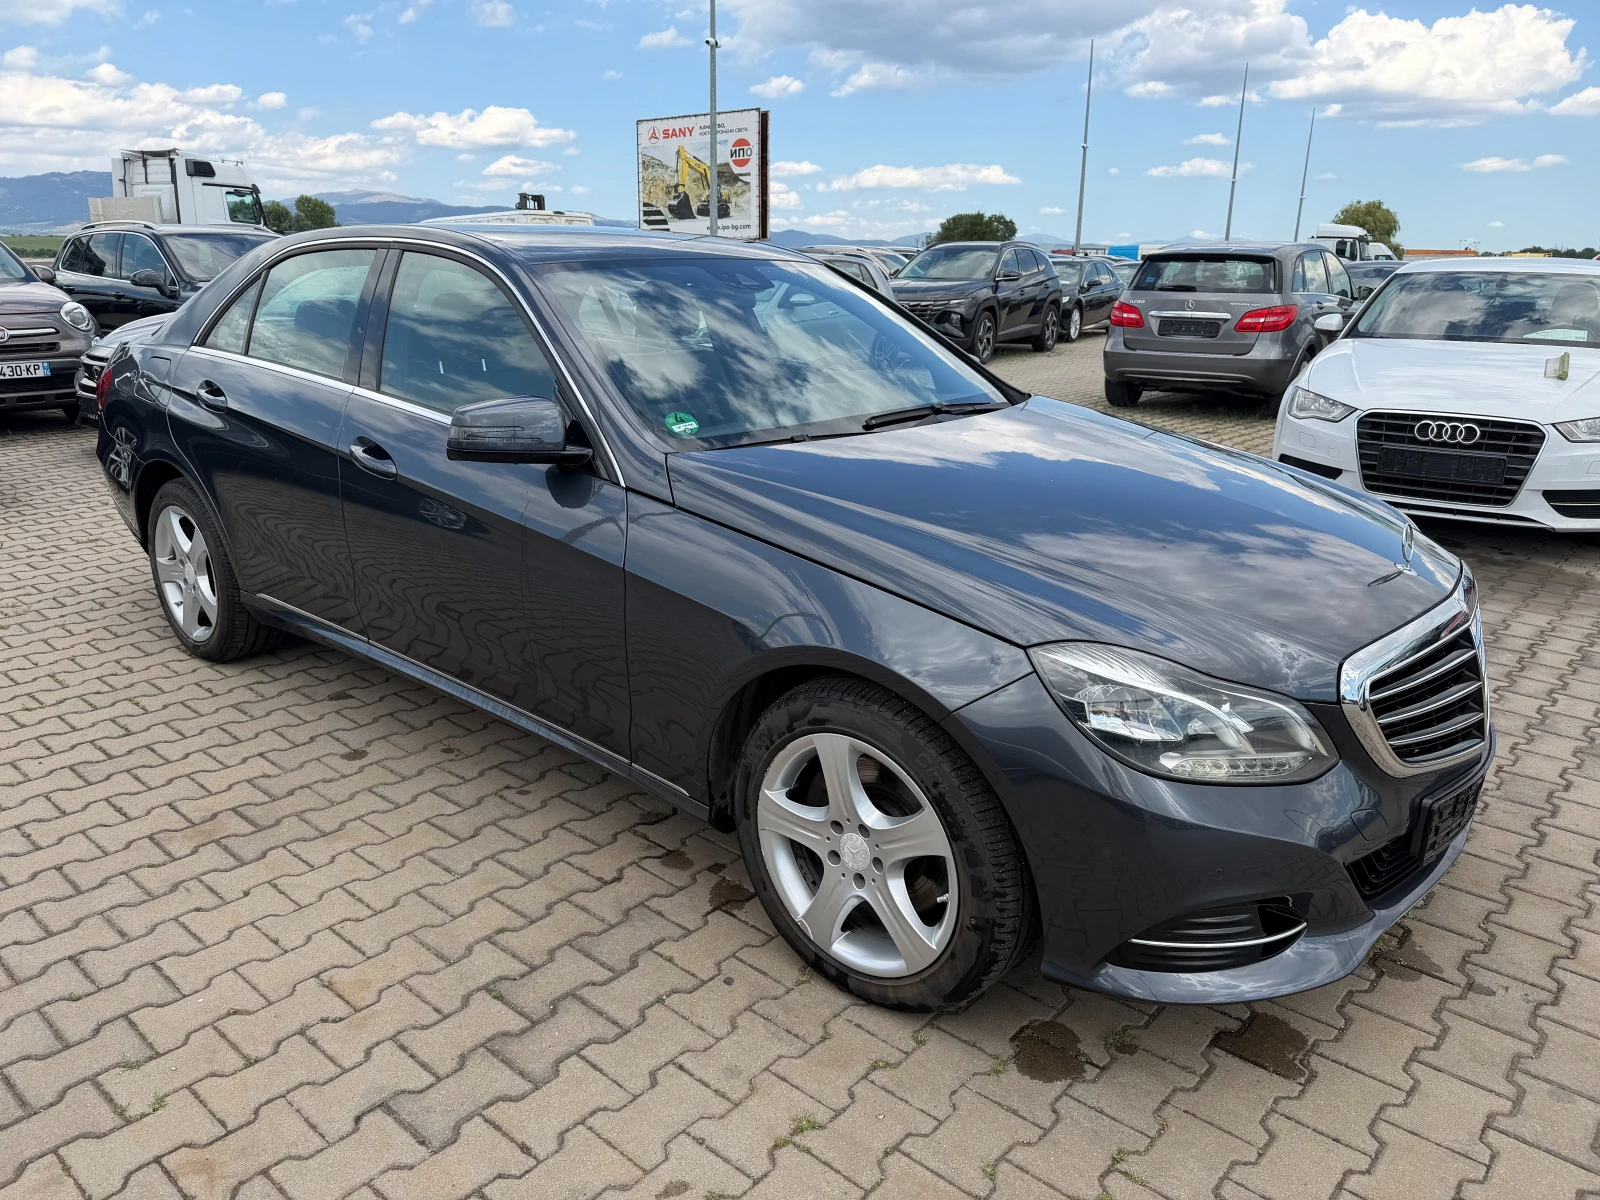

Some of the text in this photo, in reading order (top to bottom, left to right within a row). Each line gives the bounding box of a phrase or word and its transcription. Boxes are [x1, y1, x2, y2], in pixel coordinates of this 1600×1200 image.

[662, 126, 695, 139] SANY
[730, 147, 753, 159] ИПО
[0, 364, 40, 377] 430-KP
[674, 412, 685, 423] 4
